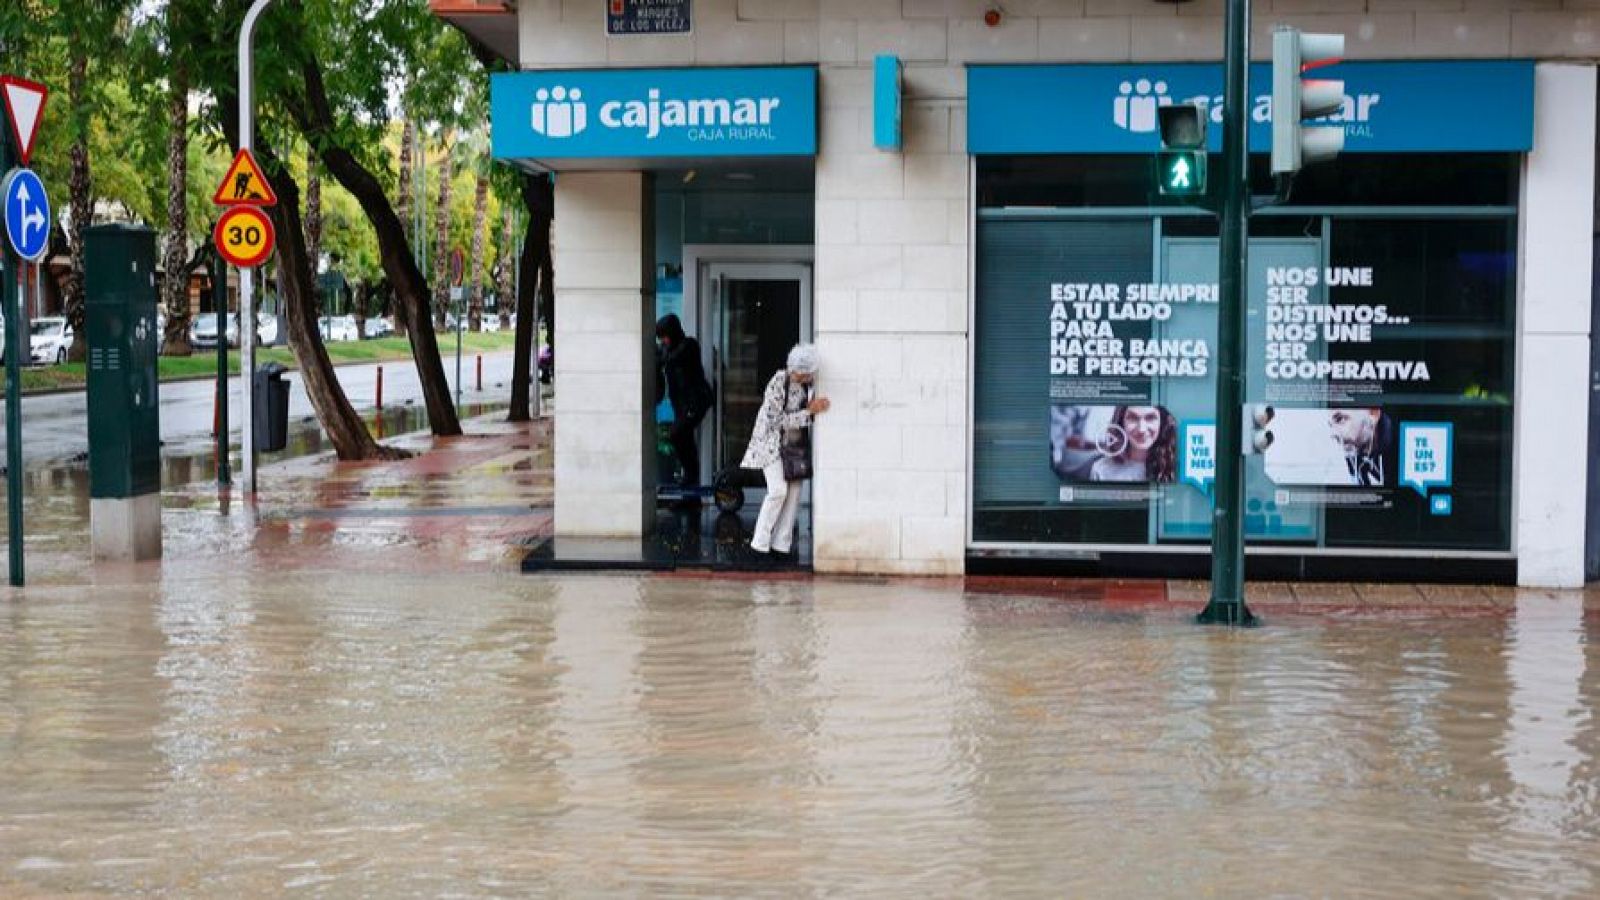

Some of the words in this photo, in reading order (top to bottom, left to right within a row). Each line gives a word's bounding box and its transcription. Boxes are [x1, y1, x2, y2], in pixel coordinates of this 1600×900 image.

[599, 88, 780, 139] cajamar
[687, 128, 725, 141] CAJA
[729, 127, 776, 139] RURAL
[228, 226, 261, 246] 30
[1267, 267, 1318, 286] NOS
[1325, 267, 1373, 286] UNE
[1050, 283, 1120, 301] ESTAR
[1266, 286, 1308, 304] SER
[1050, 302, 1068, 320] A
[1073, 302, 1101, 320] TU
[1108, 302, 1172, 320] LADO
[1266, 305, 1410, 324] DISTINTOS...
[1050, 320, 1114, 338] PARA
[1266, 324, 1318, 342] NOS
[1324, 324, 1372, 342] UNE
[1050, 339, 1124, 357] HACER
[1129, 339, 1209, 357] BANCA
[1266, 343, 1308, 361] SER
[1050, 357, 1079, 375] DE
[1085, 357, 1208, 375] PERSONAS
[1265, 361, 1430, 380] COOPERATIVA
[1415, 436, 1428, 447] TE
[1415, 449, 1433, 459] UN
[1414, 462, 1436, 472] ES?
